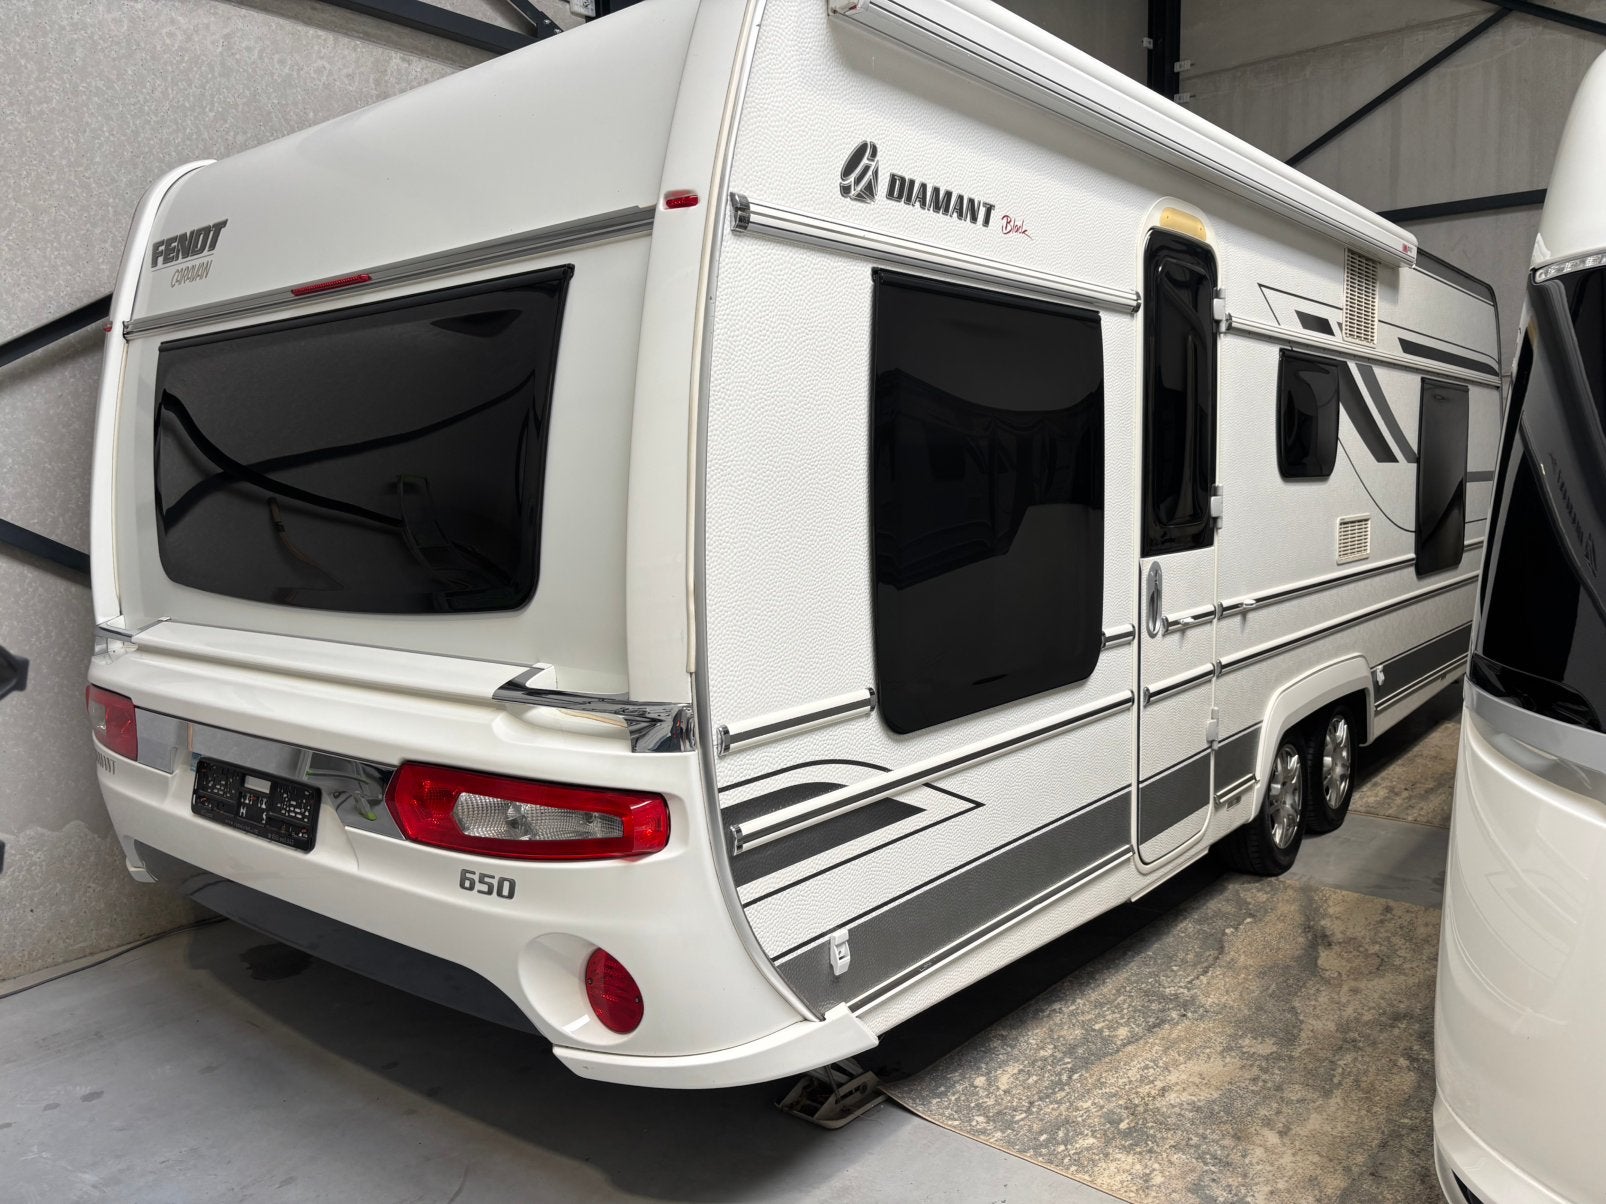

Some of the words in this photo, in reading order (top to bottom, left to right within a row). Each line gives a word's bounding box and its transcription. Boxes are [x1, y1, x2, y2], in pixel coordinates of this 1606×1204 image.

[885, 172, 996, 228] DIAMANT
[151, 218, 228, 268] FENDT
[170, 259, 213, 288] CARAVAN
[459, 868, 517, 900] 650
